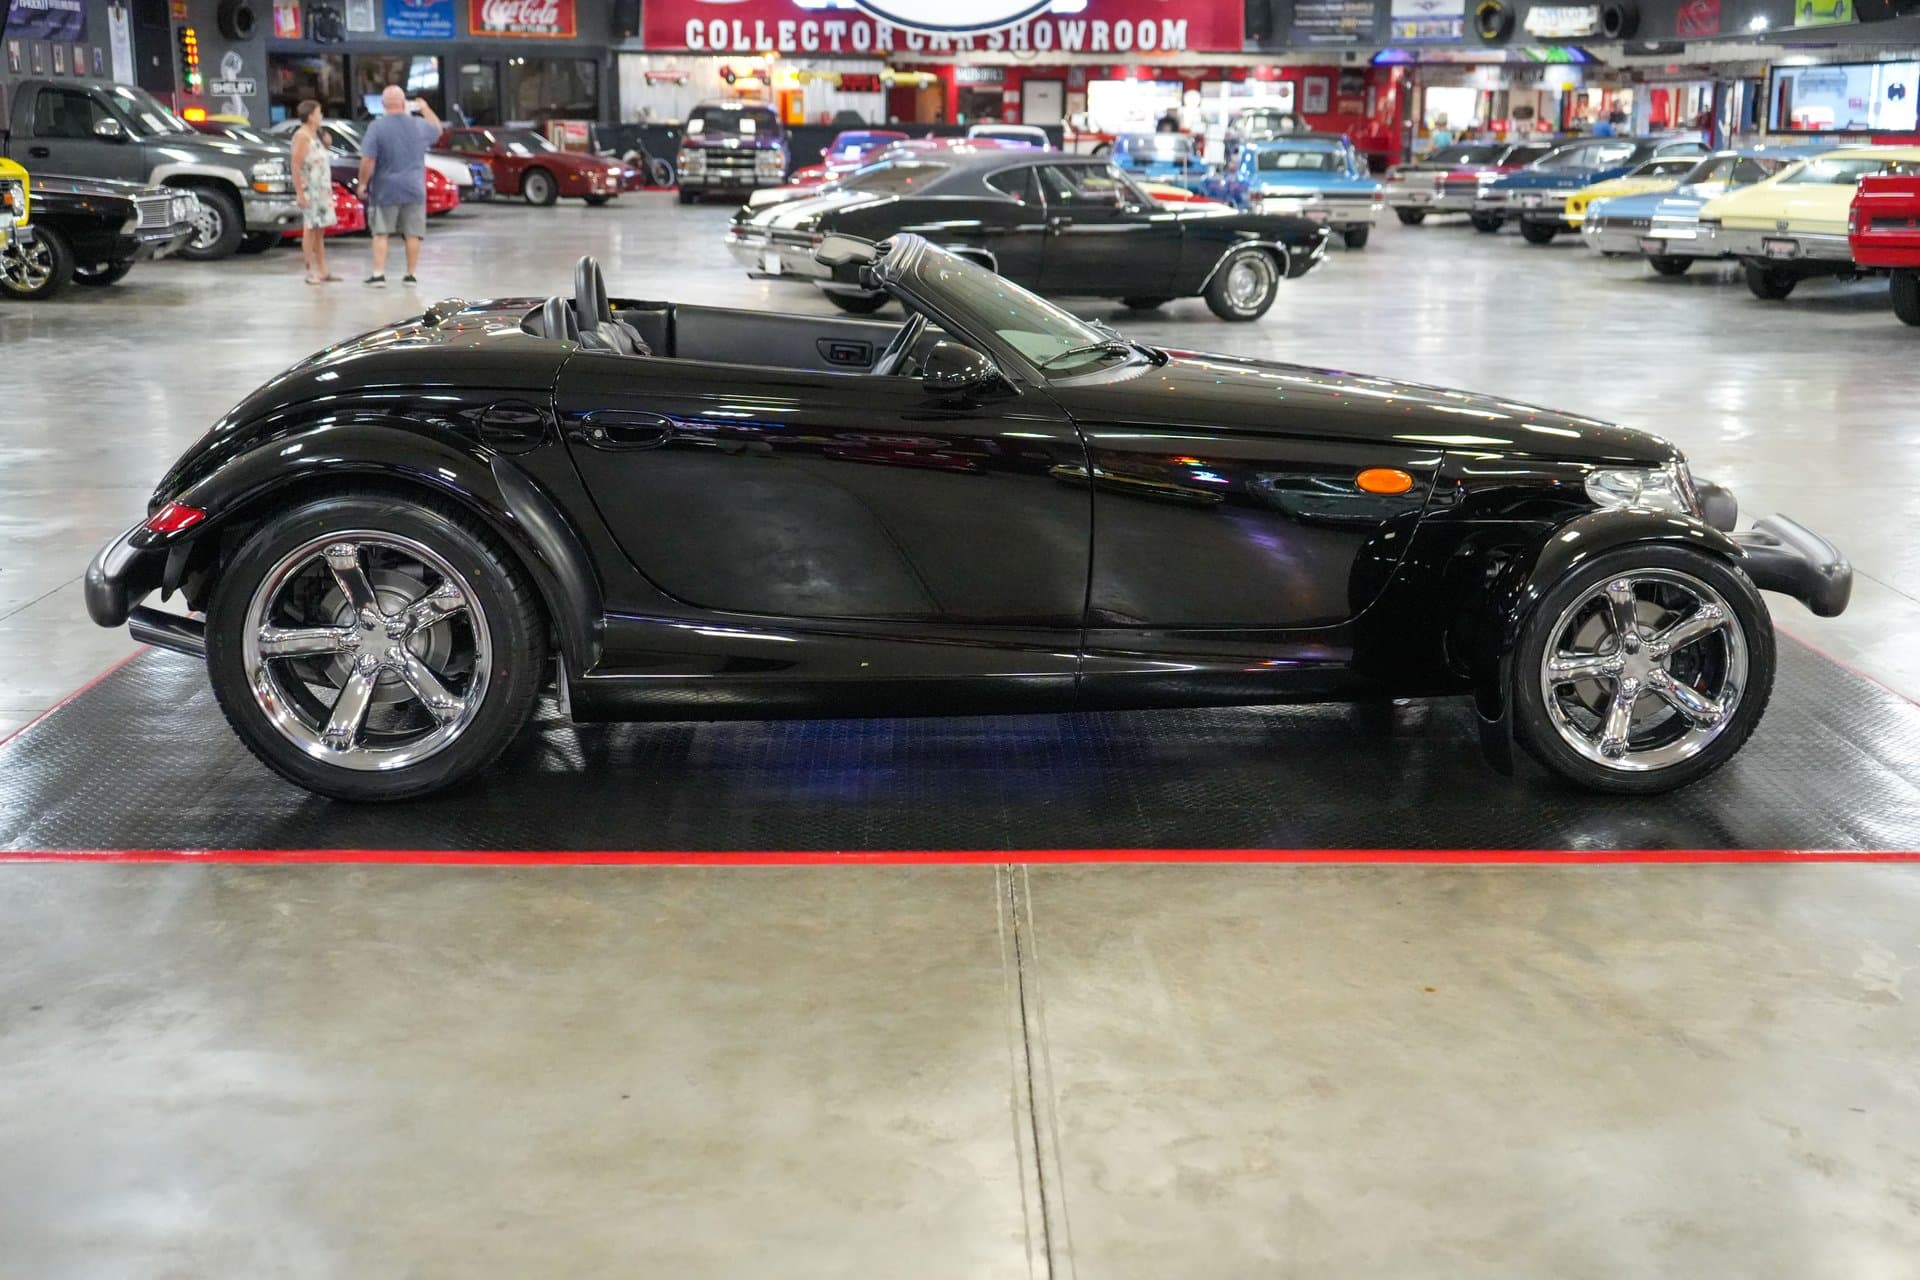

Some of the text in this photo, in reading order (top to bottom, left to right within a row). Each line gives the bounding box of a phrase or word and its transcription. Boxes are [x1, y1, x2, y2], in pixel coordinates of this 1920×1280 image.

[685, 19, 894, 51] COLLECTOR
[986, 19, 1188, 51] SHOWROOM
[212, 82, 254, 94] SHELBY
